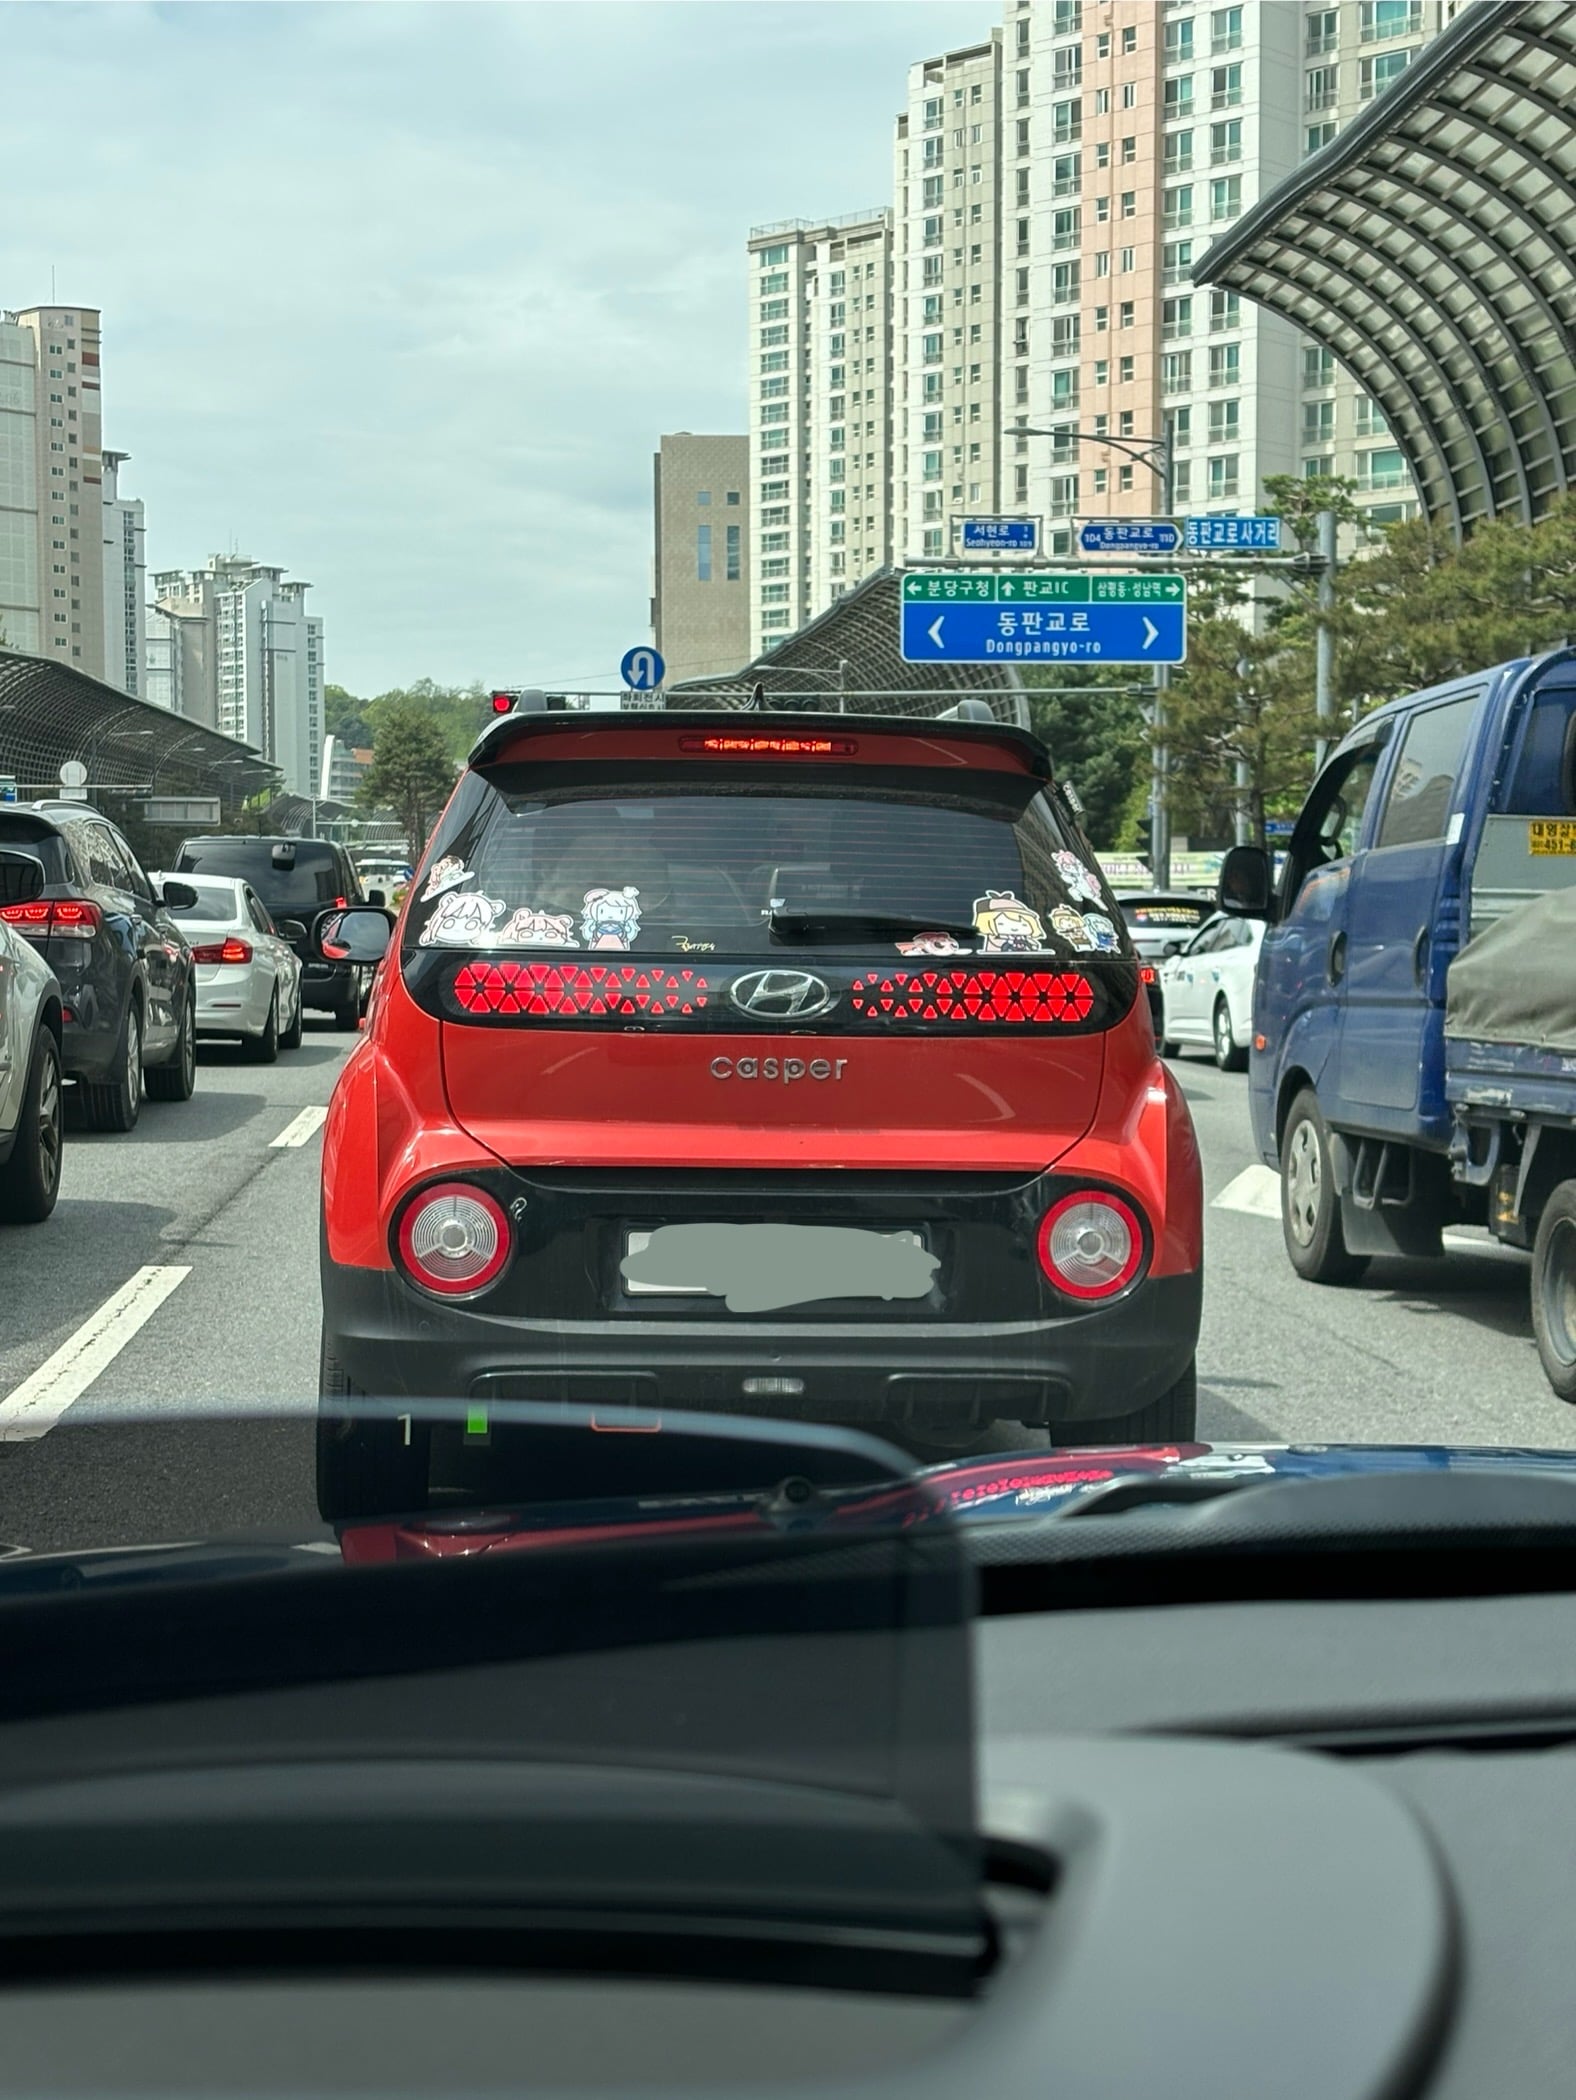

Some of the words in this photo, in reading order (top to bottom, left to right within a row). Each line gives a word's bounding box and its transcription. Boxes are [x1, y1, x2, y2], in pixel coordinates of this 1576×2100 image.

[973, 525, 1010, 538] 서현로
[1084, 533, 1101, 544] 104
[1103, 526, 1154, 541] 동판교로
[1159, 533, 1175, 544] 110
[1186, 520, 1280, 546] 동판교로사거리
[966, 538, 1018, 548] Seohyeon-ro
[1099, 542, 1160, 551] Dongpangyo-ro
[927, 580, 990, 598] 분당구청
[1023, 580, 1070, 596] 판교IC
[997, 611, 1091, 637] 동판교로
[986, 639, 1102, 656] Dongpangyo-ro
[710, 1056, 848, 1084] casper
[397, 1413, 412, 1446] 1
